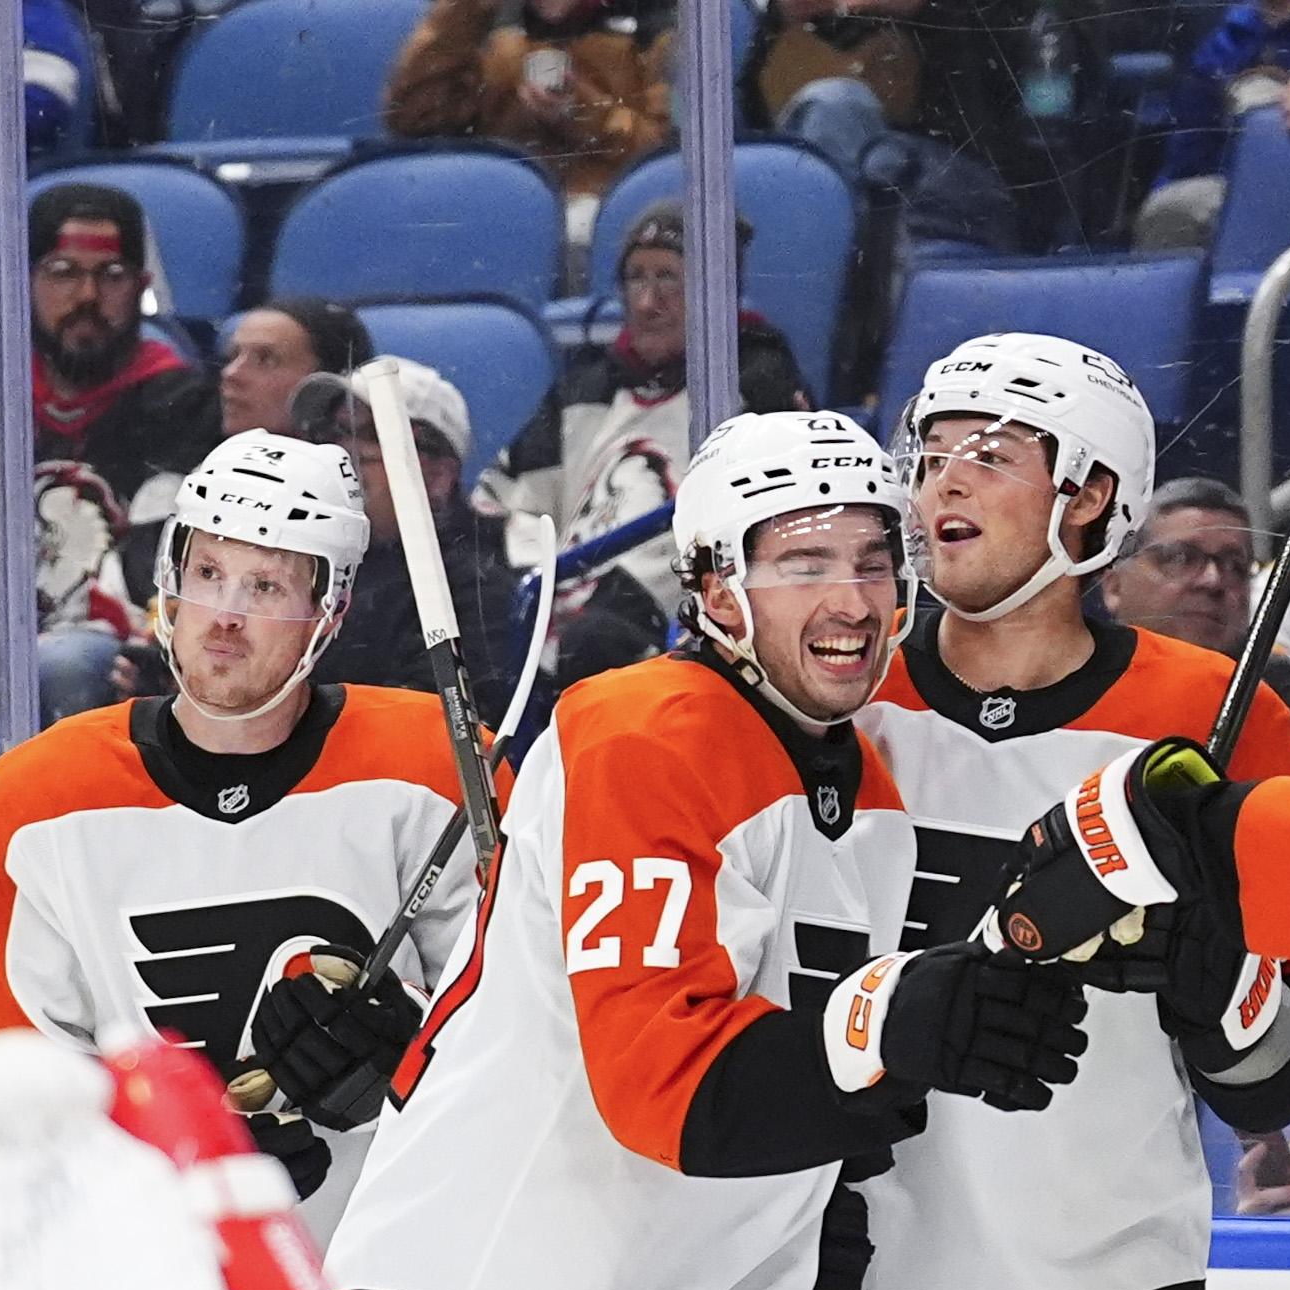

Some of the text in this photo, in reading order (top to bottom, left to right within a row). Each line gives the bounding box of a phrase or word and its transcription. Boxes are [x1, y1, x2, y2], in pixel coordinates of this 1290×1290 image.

[939, 361, 994, 375] CCM
[810, 456, 874, 469] CCM
[219, 492, 274, 512] CCM
[409, 870, 439, 915] CCM
[566, 857, 693, 976] 27
